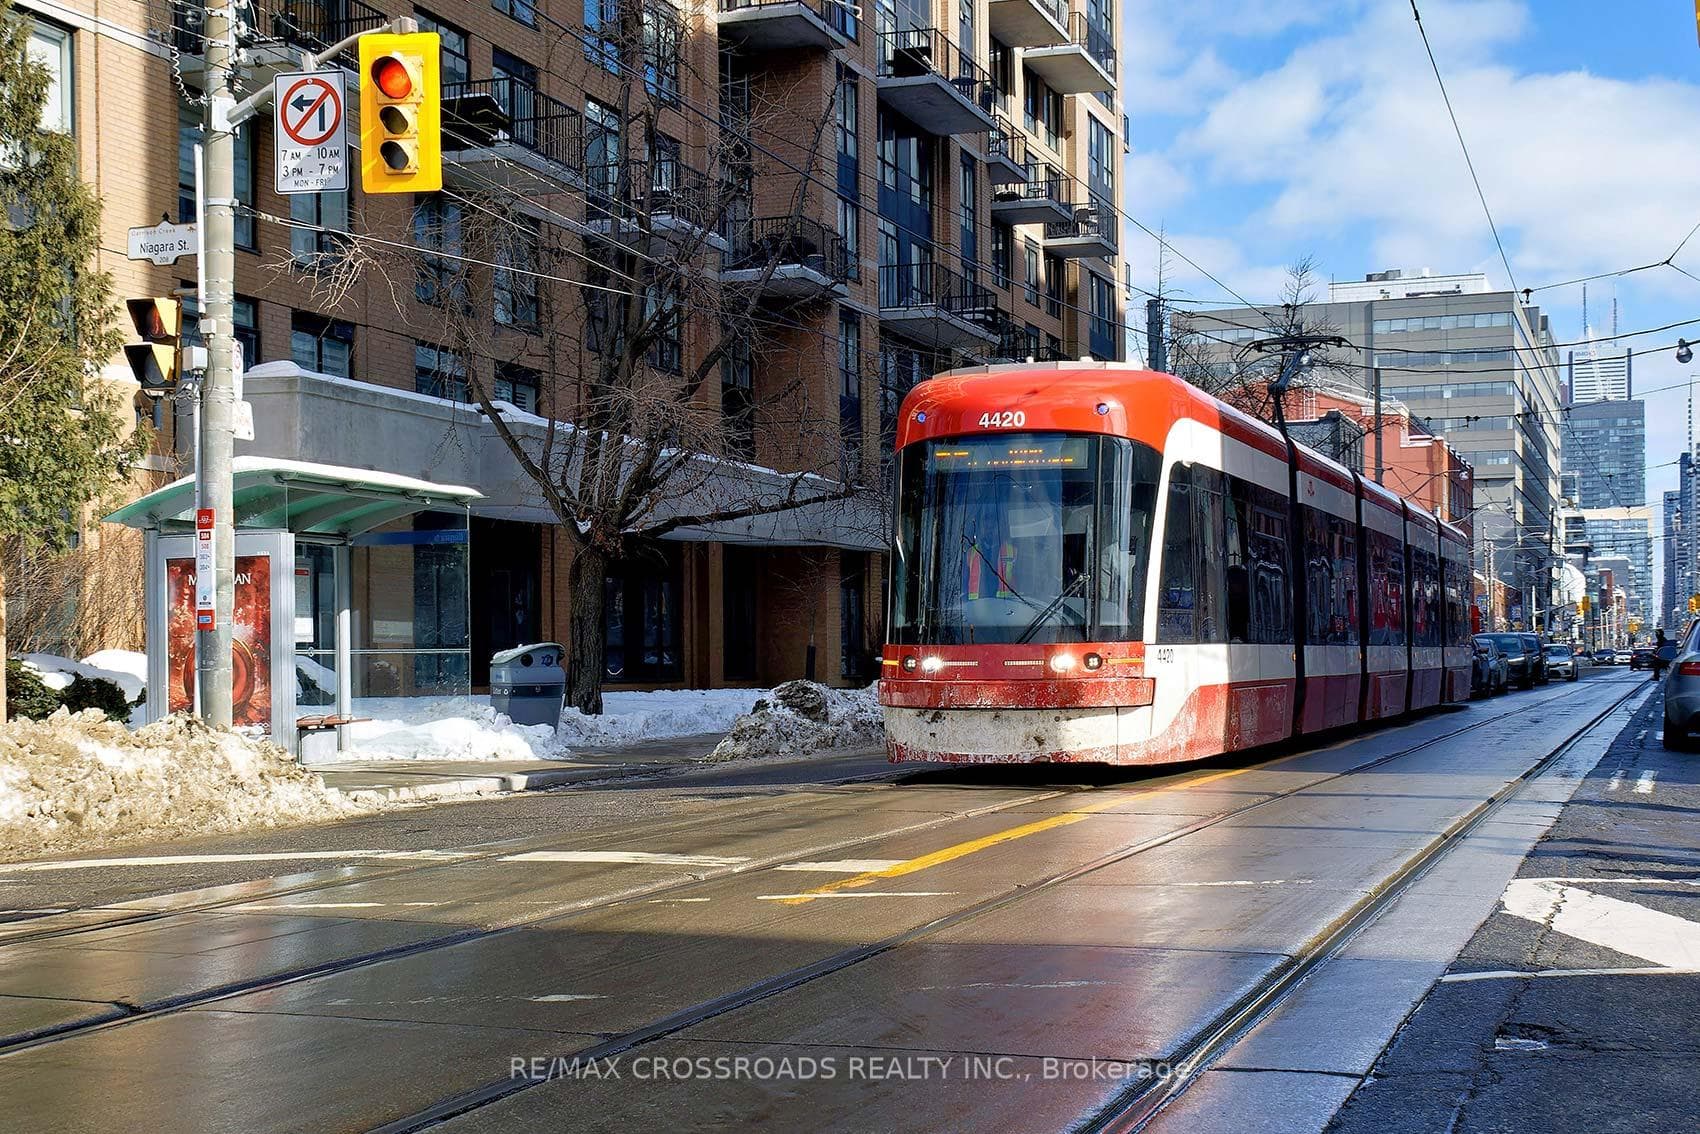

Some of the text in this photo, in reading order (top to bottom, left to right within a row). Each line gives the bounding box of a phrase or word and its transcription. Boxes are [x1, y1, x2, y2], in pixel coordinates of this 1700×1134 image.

[281, 150, 288, 161] 7
[290, 152, 302, 160] AM
[317, 147, 327, 159] 10
[328, 150, 340, 159] AM
[282, 166, 289, 177] 3
[292, 168, 303, 177] PM
[319, 164, 326, 175] 7
[328, 165, 339, 175] PM
[140, 240, 190, 255] Niagara St.
[978, 411, 1026, 428] 4420
[1157, 649, 1174, 663] 4420
